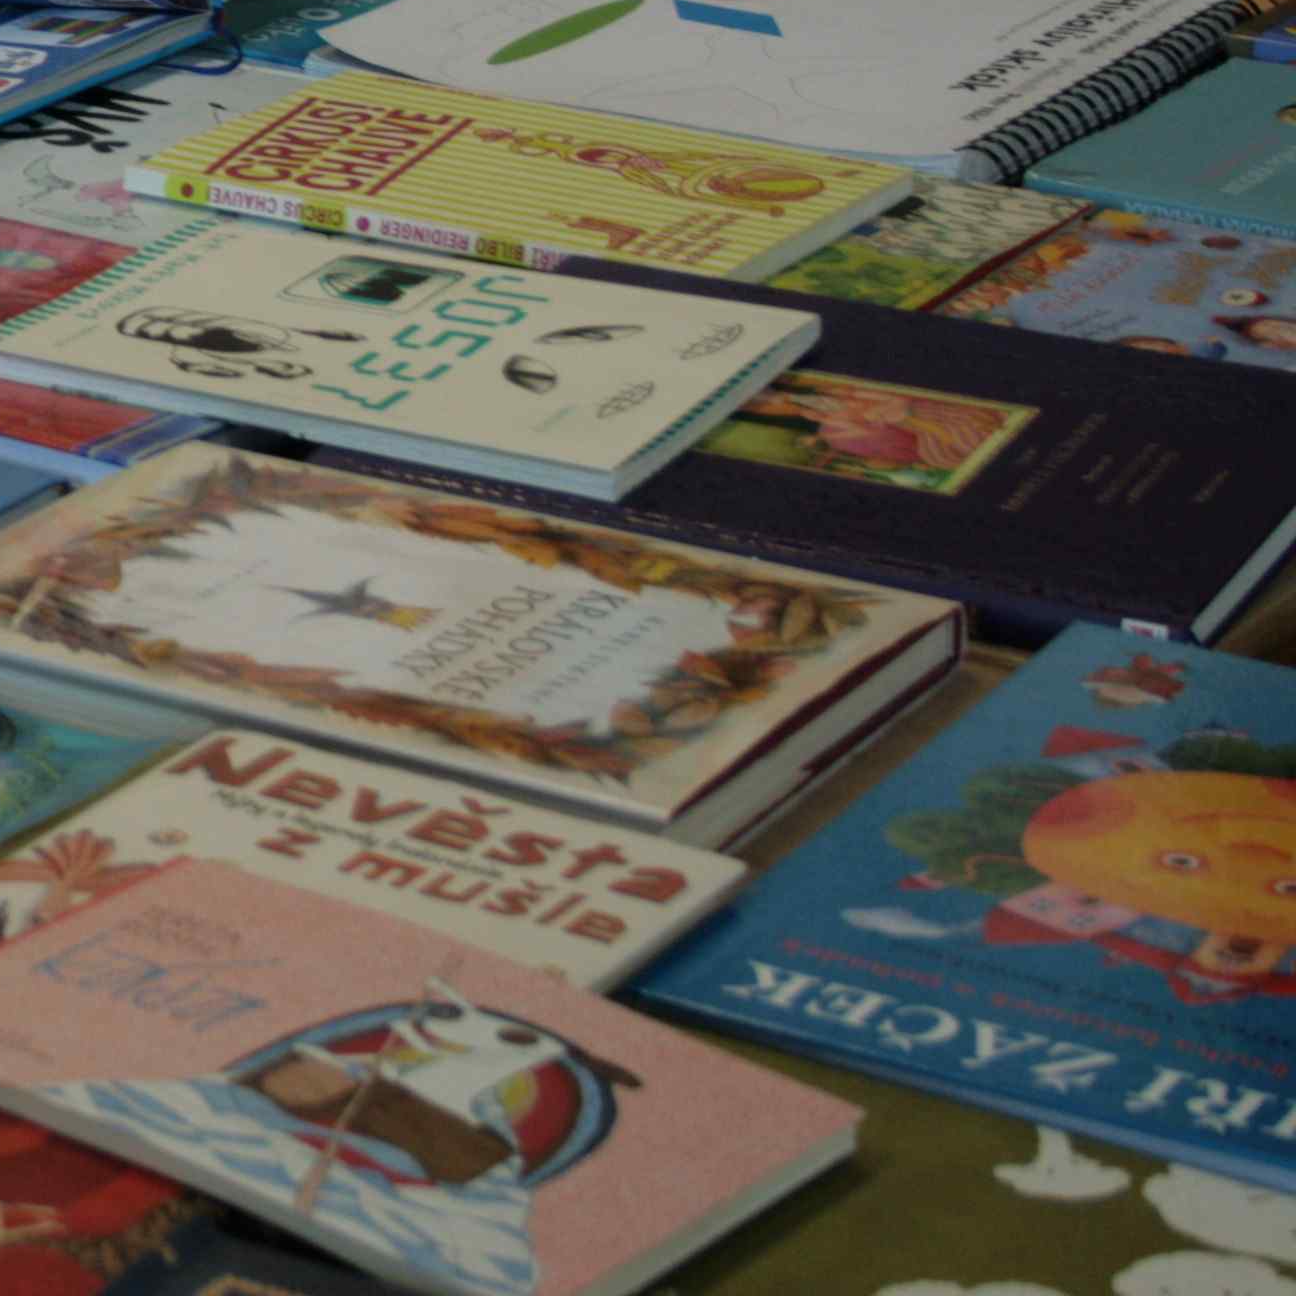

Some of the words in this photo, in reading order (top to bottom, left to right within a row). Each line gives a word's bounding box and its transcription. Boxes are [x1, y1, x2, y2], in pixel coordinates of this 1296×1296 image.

[296, 108, 453, 192] CHAUVE
[379, 219, 470, 252] REIDINGER
[475, 238, 524, 264] BILBO
[165, 735, 689, 903] Nevěsta
[337, 848, 628, 944] mušle
[721, 960, 1119, 1093] ŽÁČEK
